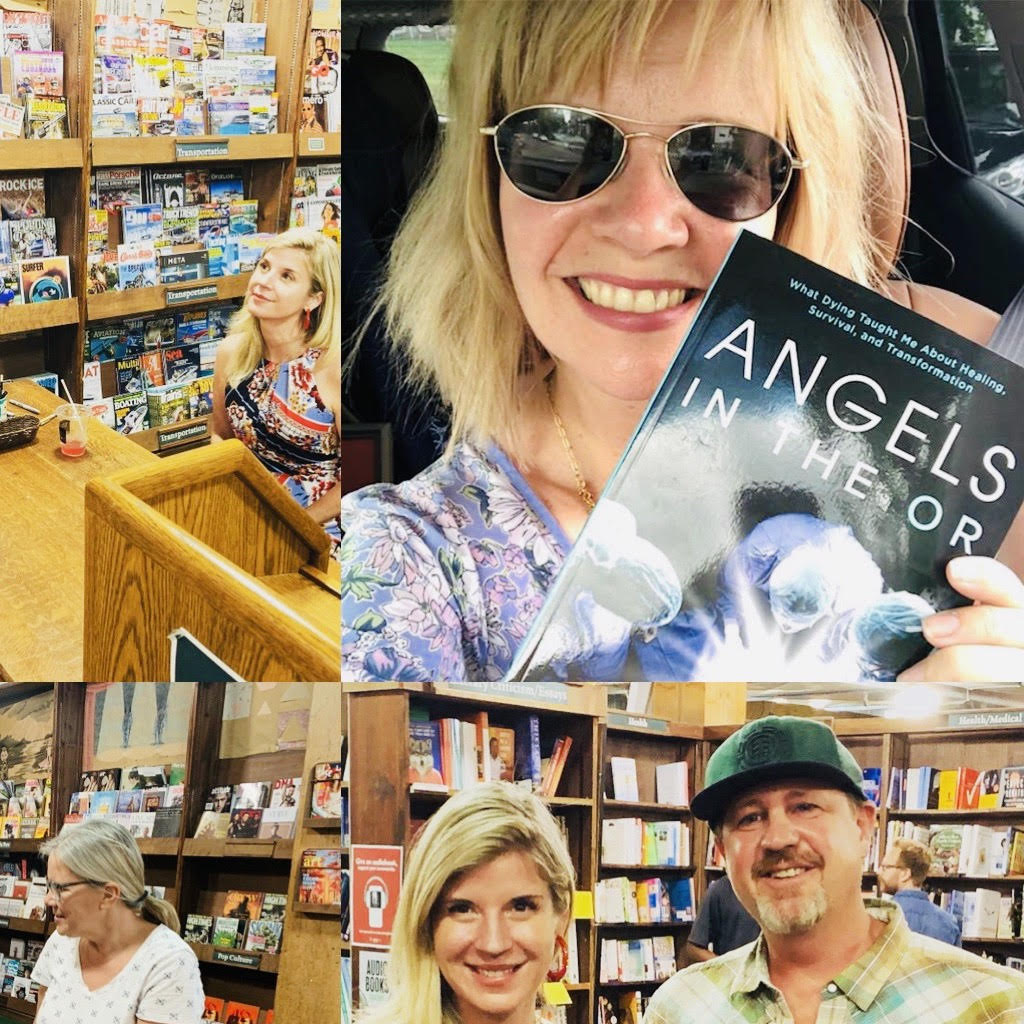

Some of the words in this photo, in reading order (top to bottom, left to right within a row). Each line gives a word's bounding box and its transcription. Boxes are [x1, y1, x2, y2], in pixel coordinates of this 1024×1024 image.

[21, 262, 45, 272] SURFER
[167, 286, 217, 300] Transportation
[789, 277, 819, 300] What
[821, 292, 856, 320] Dying
[860, 311, 899, 340] Taught
[900, 331, 919, 349] Me
[920, 342, 958, 367] About
[959, 362, 1007, 396] Healing,
[808, 304, 858, 337] Survival,
[860, 330, 885, 349] and
[886, 340, 974, 394] Transformation
[160, 425, 207, 442] Transportation
[703, 318, 1017, 503] ANGELS
[681, 377, 742, 429] IN
[772, 419, 880, 500] THE
[907, 494, 984, 555] OR
